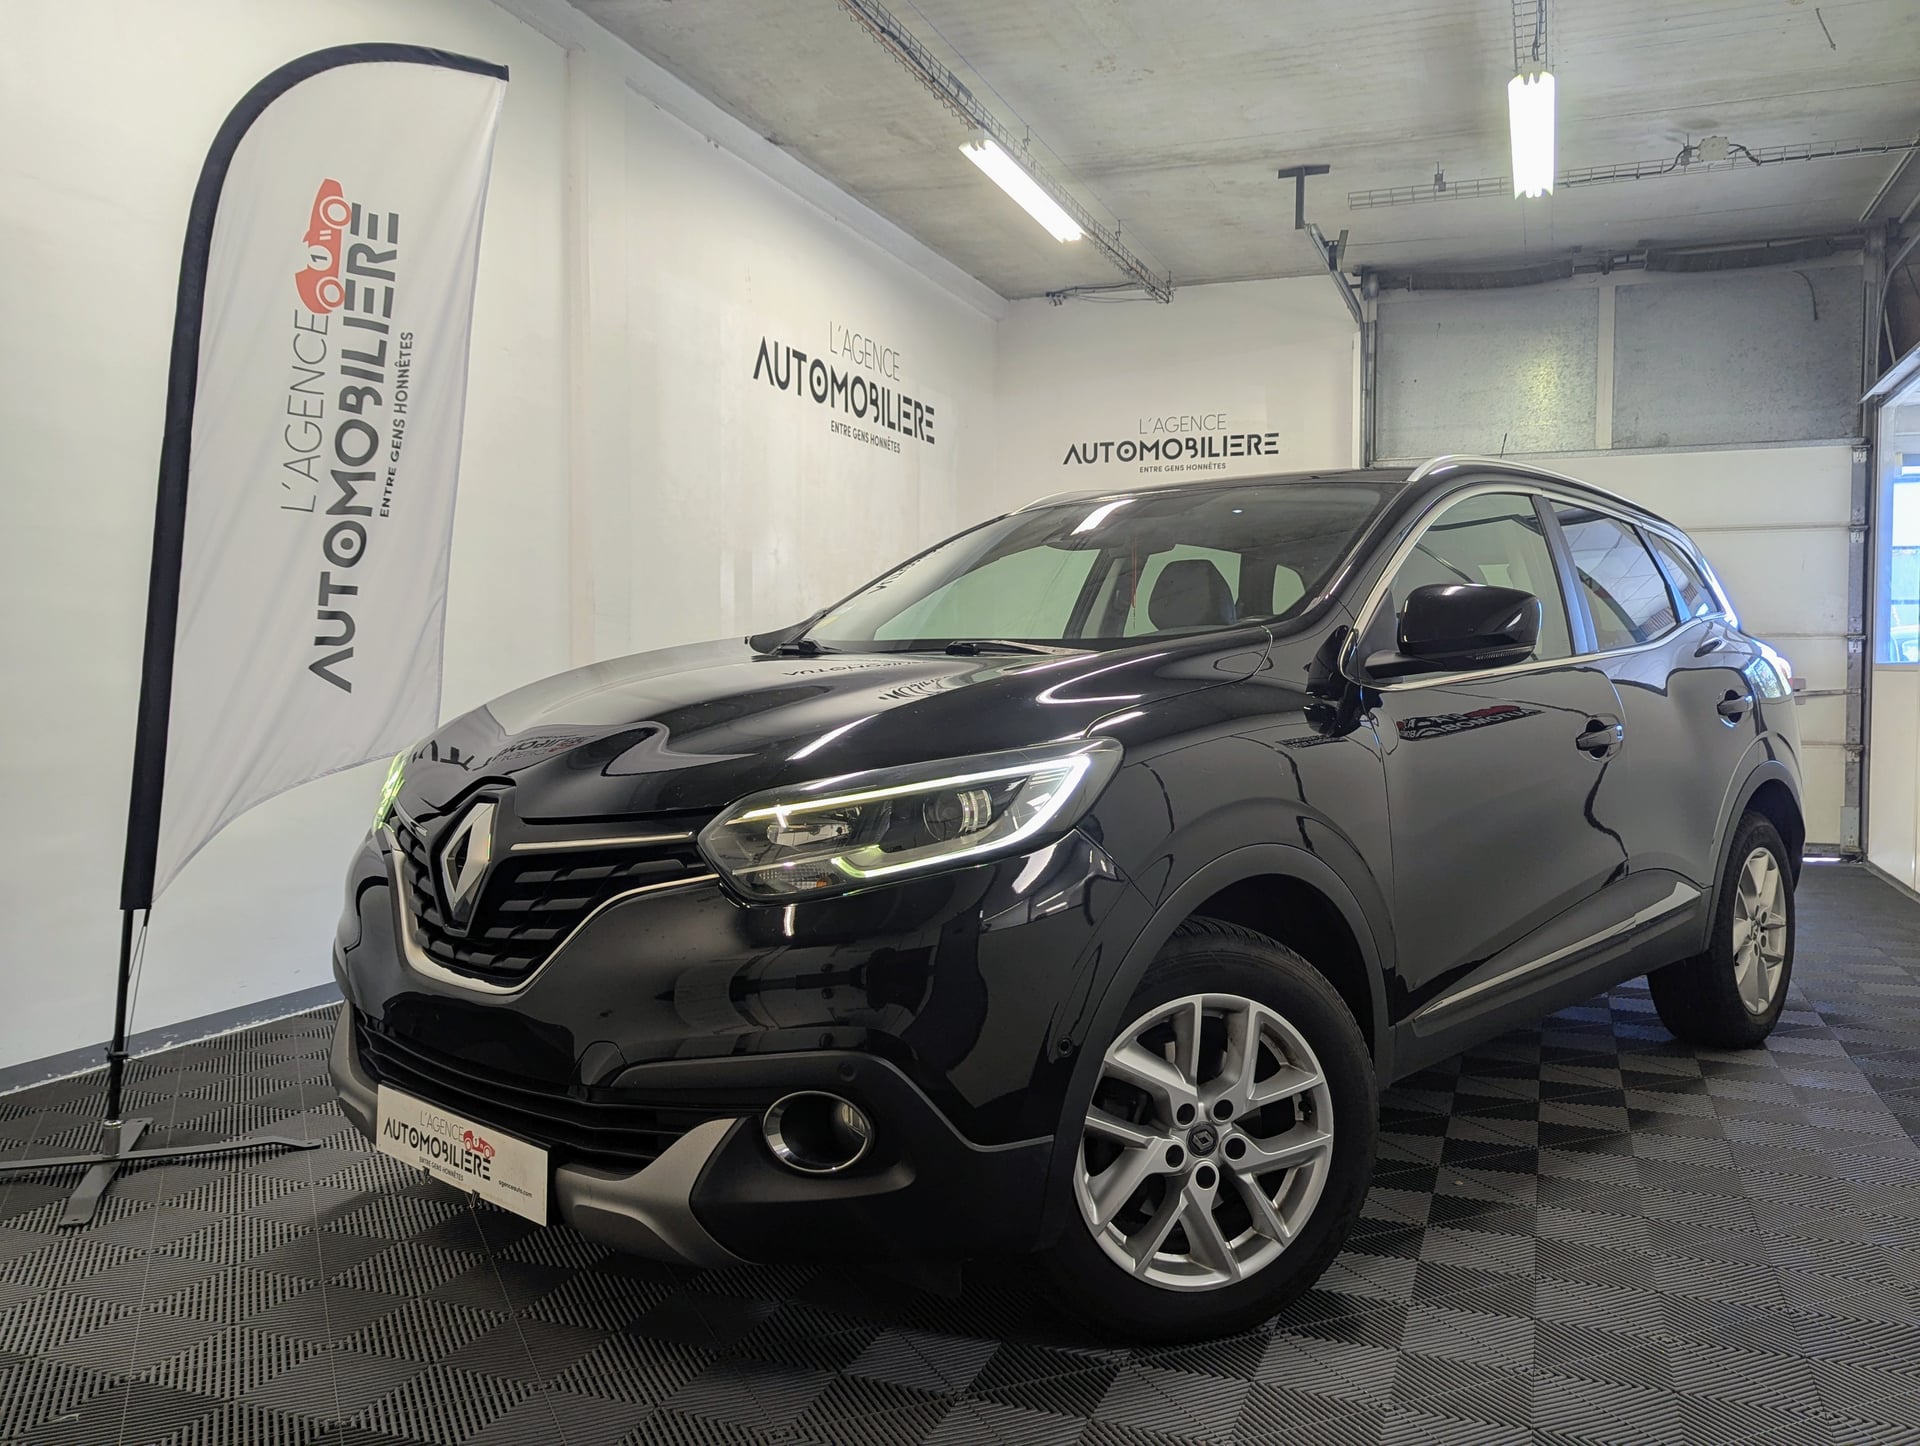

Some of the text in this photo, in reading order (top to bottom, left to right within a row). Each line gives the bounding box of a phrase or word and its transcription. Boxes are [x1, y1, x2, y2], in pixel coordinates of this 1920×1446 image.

[829, 320, 900, 382] L'AGENCE
[280, 309, 329, 512] L'AGENCE
[753, 335, 935, 445] AUTOMOBILIERE
[308, 202, 399, 694] AUTOMOBILIERE
[379, 331, 414, 518] ENTRE GENS HONNÊTES
[830, 420, 901, 454] ENTRE GENS HONNÊTES
[1139, 413, 1227, 435] L'AGENCE
[1062, 432, 1280, 465] AUTOMOBILIERE
[1139, 461, 1226, 474] ENTRE GENS HONNÊTES
[383, 1117, 491, 1182] AUTOMOBILIERE
[419, 1110, 465, 1143] L'AGENCE
[498, 1179, 533, 1198] agenceauto.com
